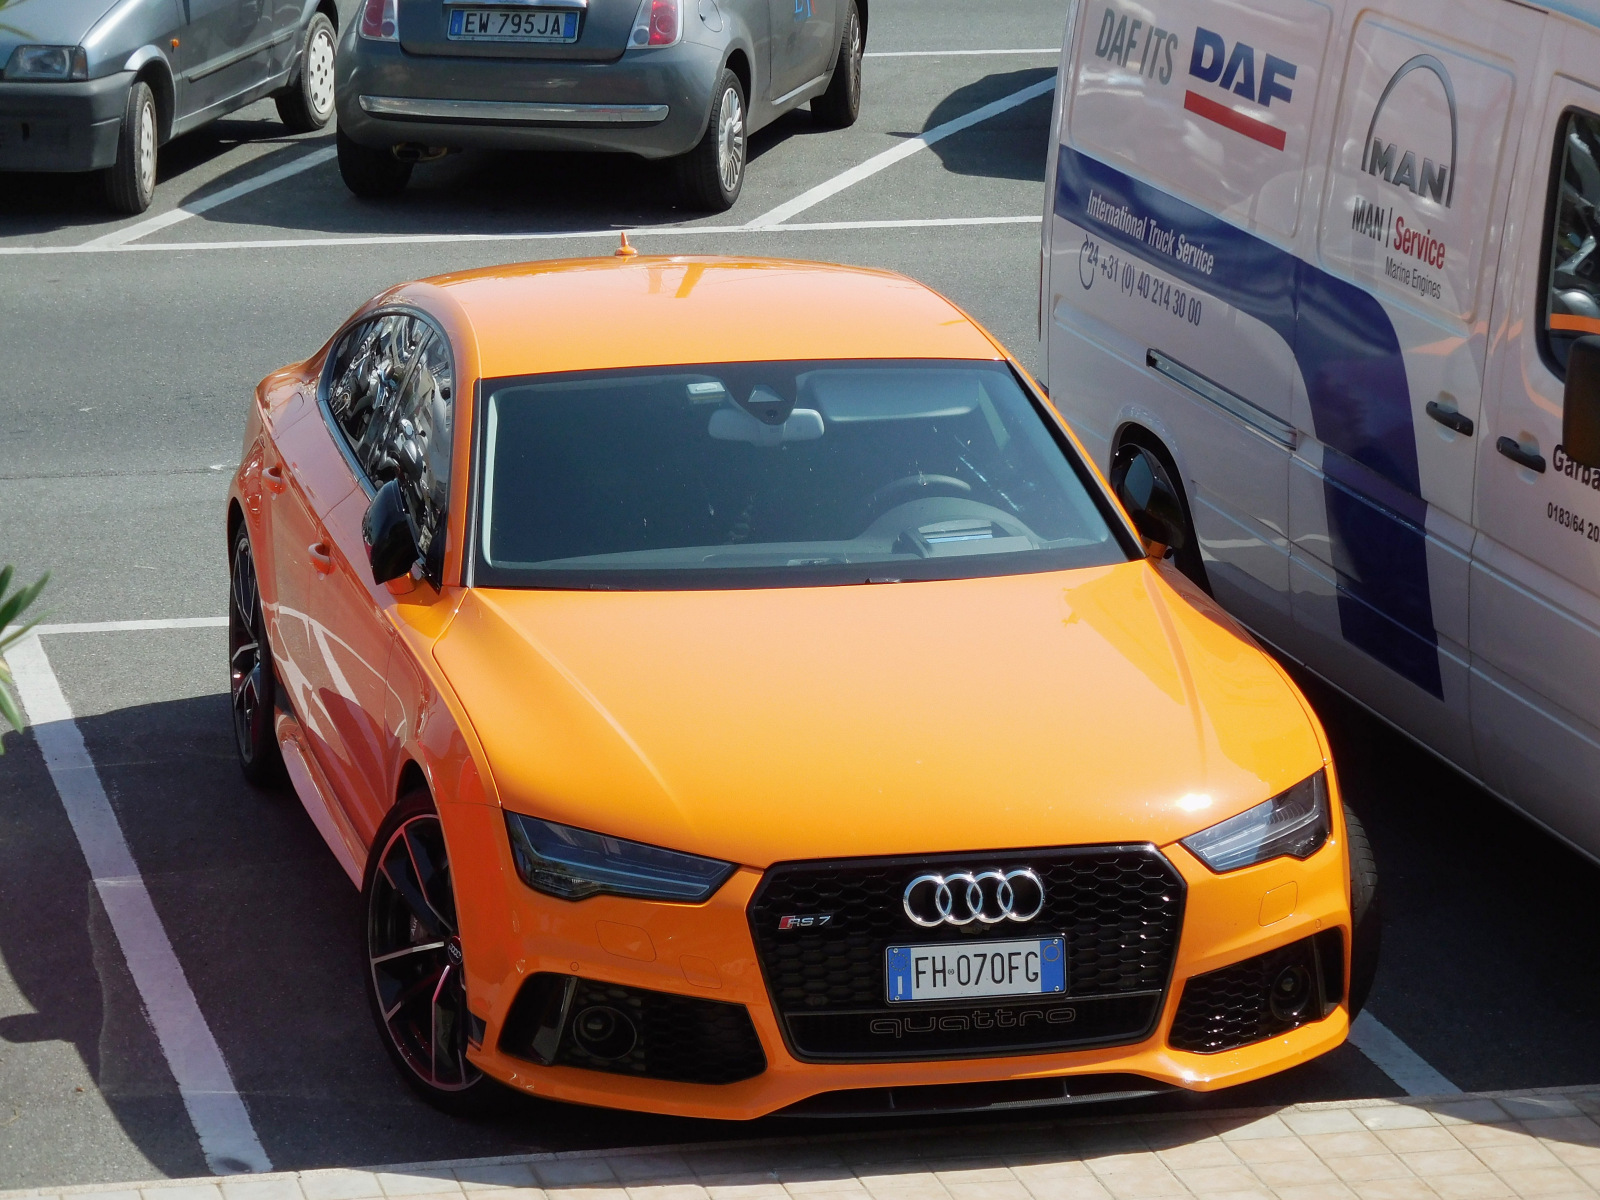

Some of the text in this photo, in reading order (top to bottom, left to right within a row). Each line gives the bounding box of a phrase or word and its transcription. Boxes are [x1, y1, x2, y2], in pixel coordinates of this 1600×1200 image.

[464, 13, 561, 36] EW 795JA
[1095, 8, 1178, 85] DAF ITS
[1189, 26, 1298, 107] DAF
[1368, 136, 1448, 205] MAN
[1086, 189, 1214, 275] International Truck Service
[1351, 197, 1446, 269] MAN Service
[1087, 241, 1202, 327] 24 +31 (0) 40 214 30 00
[1384, 255, 1442, 300] Marine Engines
[1547, 502, 1600, 544] 0183/64 20
[819, 915, 831, 926] 7
[914, 951, 1040, 989] FH 070FG
[869, 1007, 1076, 1039] quattro
